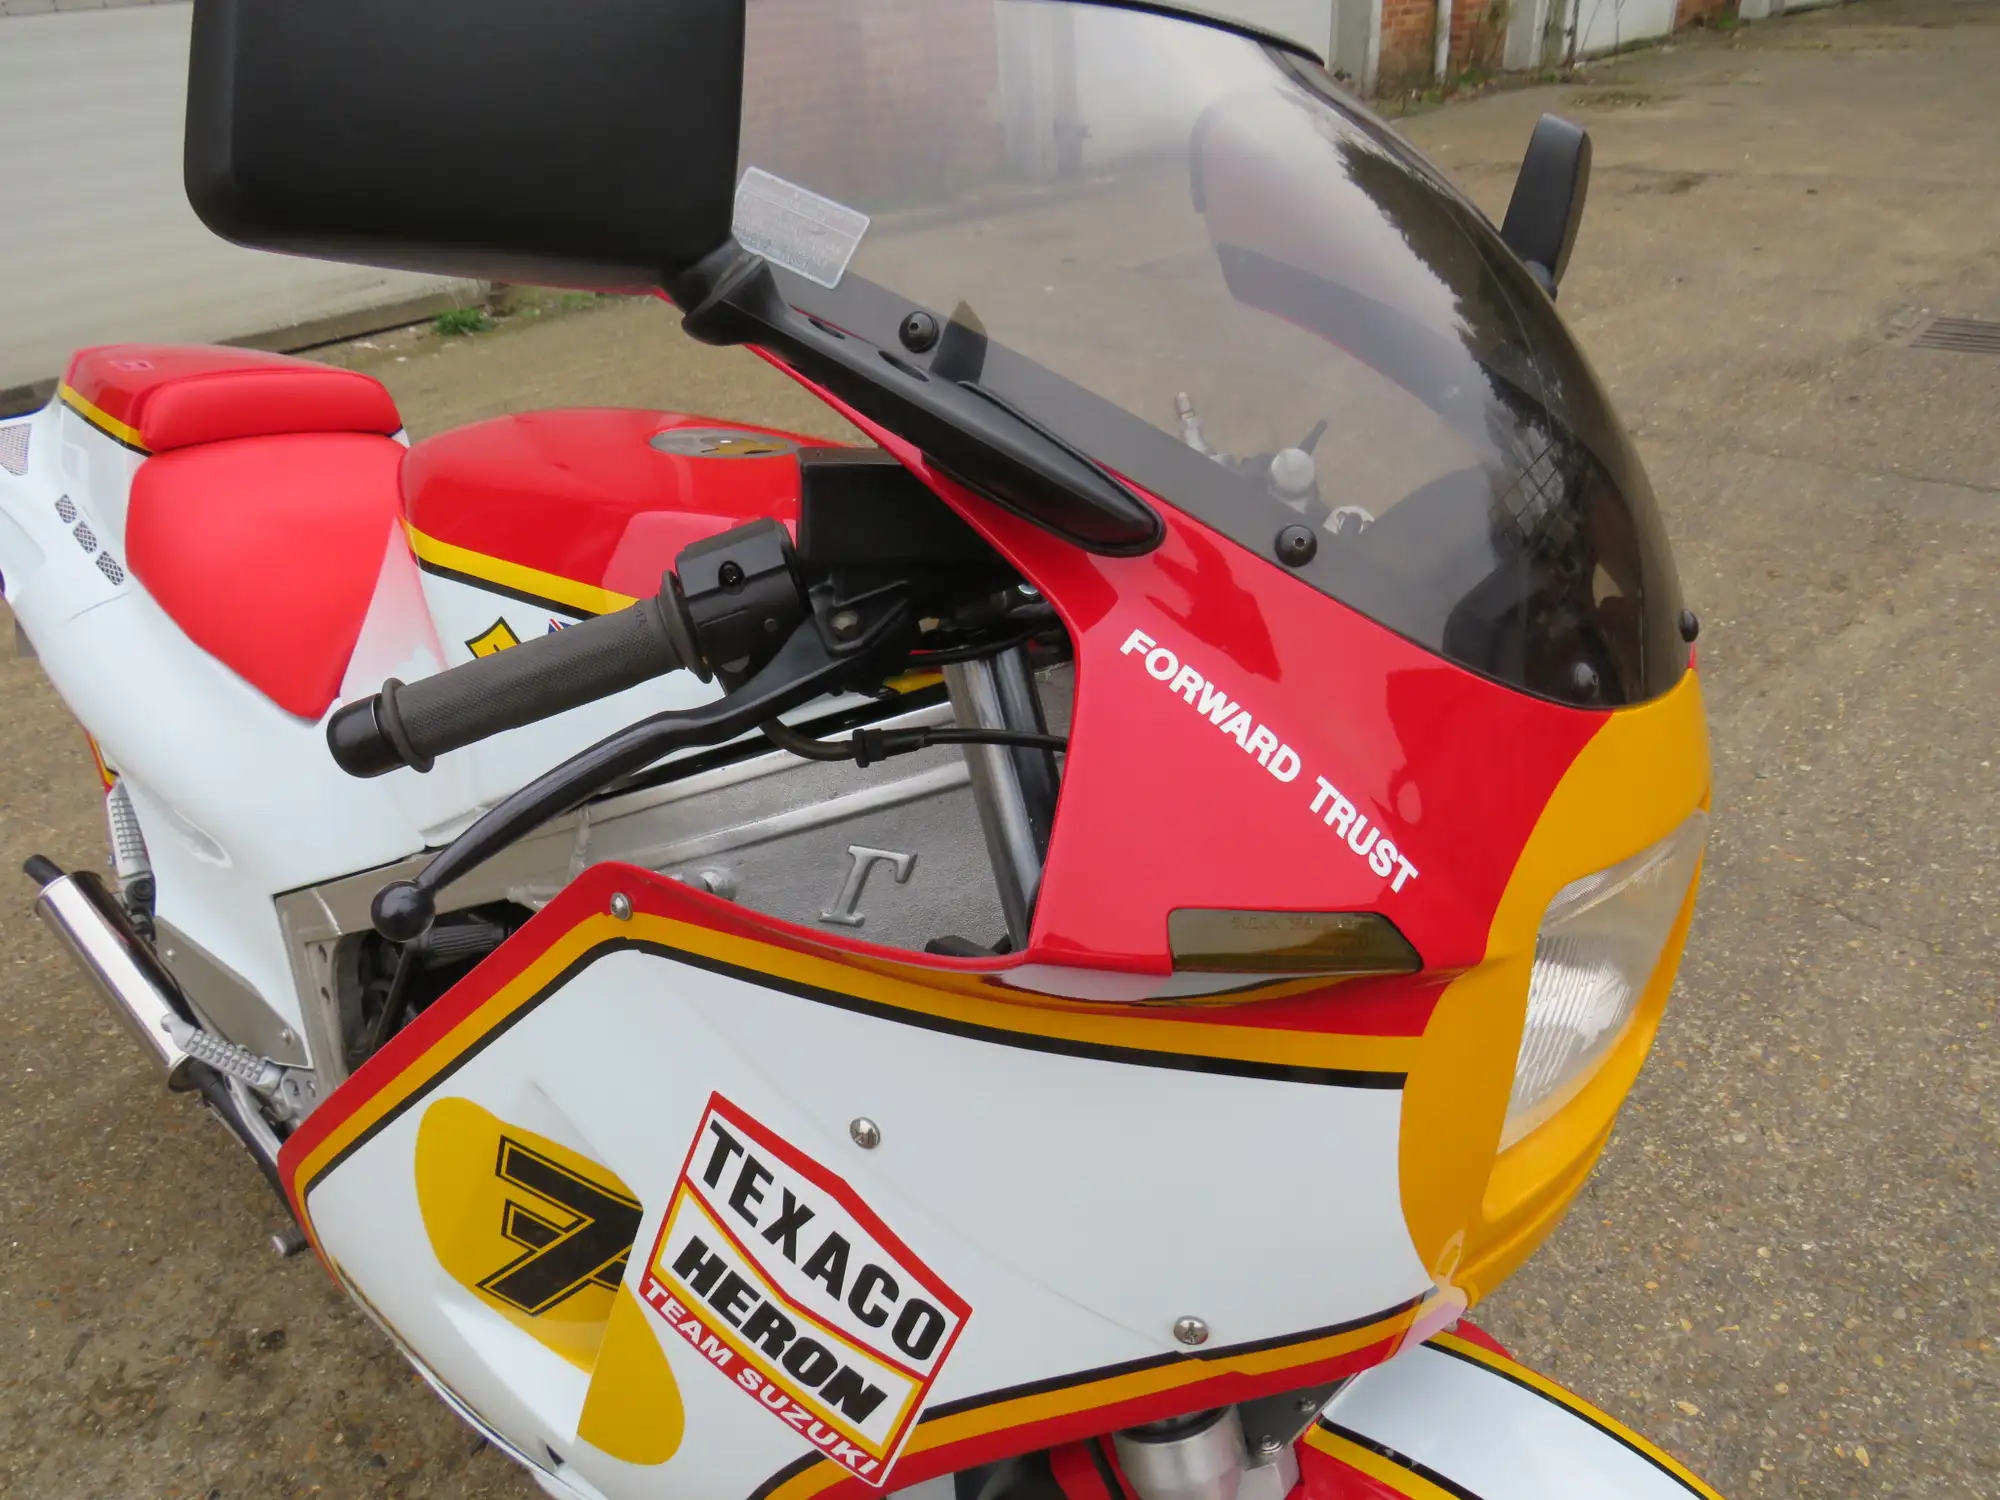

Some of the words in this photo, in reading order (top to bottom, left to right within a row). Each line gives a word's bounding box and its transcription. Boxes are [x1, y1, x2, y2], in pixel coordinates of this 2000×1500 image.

[1120, 629, 1301, 783] FORWARD
[1309, 776, 1419, 893] TRUST
[672, 1235, 888, 1424] HERON
[702, 1120, 946, 1360] TEXACO
[646, 1278, 733, 1366] TEAM
[737, 1368, 880, 1474] SUZUKI
